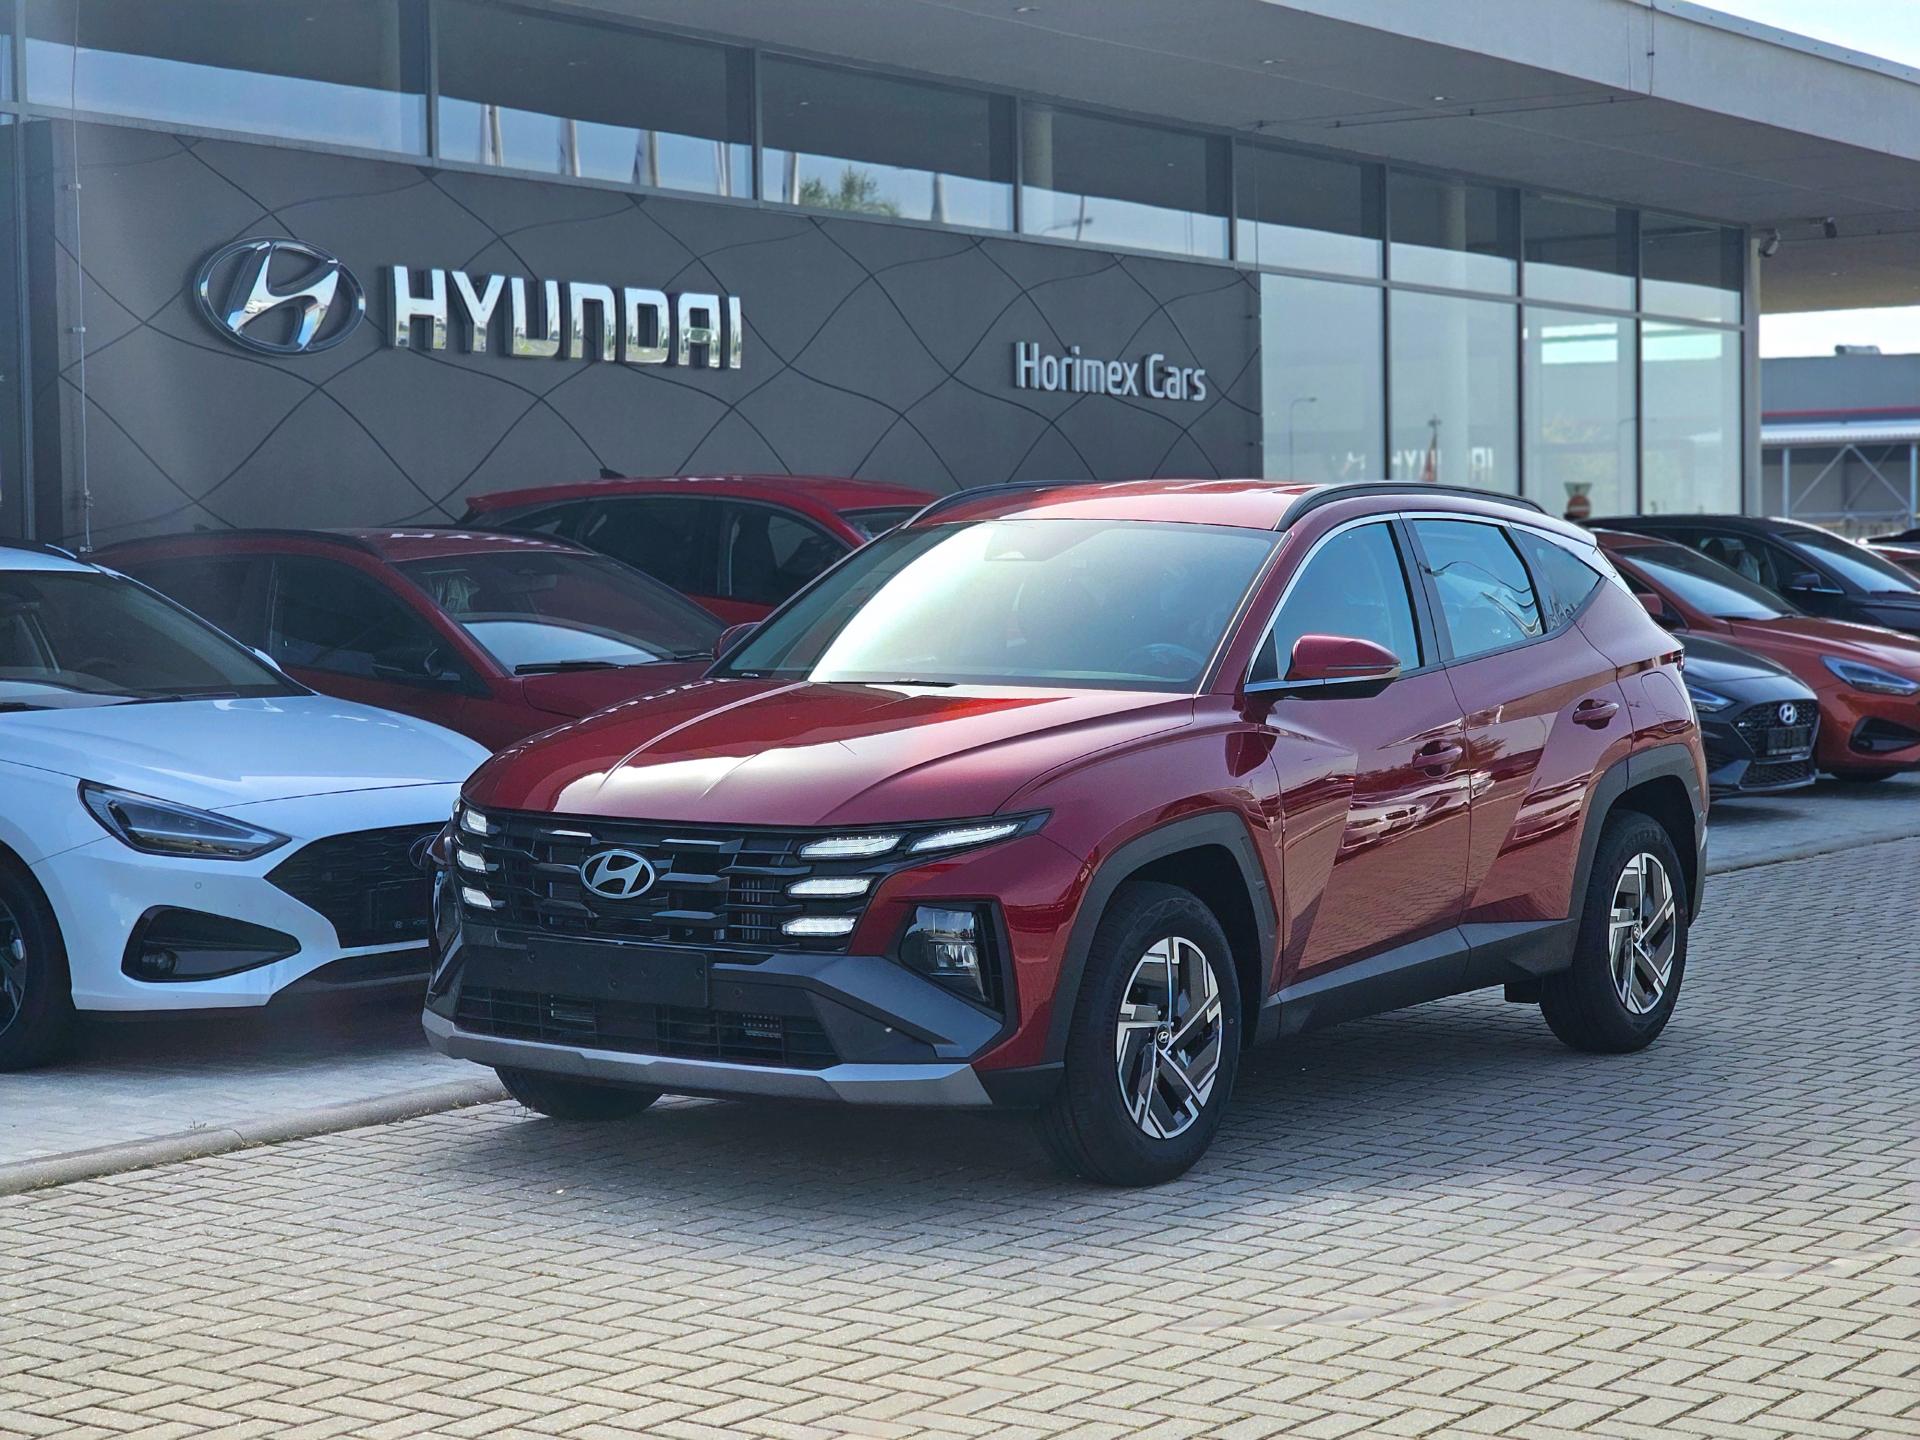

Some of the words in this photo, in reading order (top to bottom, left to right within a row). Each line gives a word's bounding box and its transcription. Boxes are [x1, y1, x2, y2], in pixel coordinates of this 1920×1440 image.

[393, 265, 742, 369] HYUNDAI
[1015, 341, 1139, 396] Horimex
[1145, 353, 1206, 401] Cars
